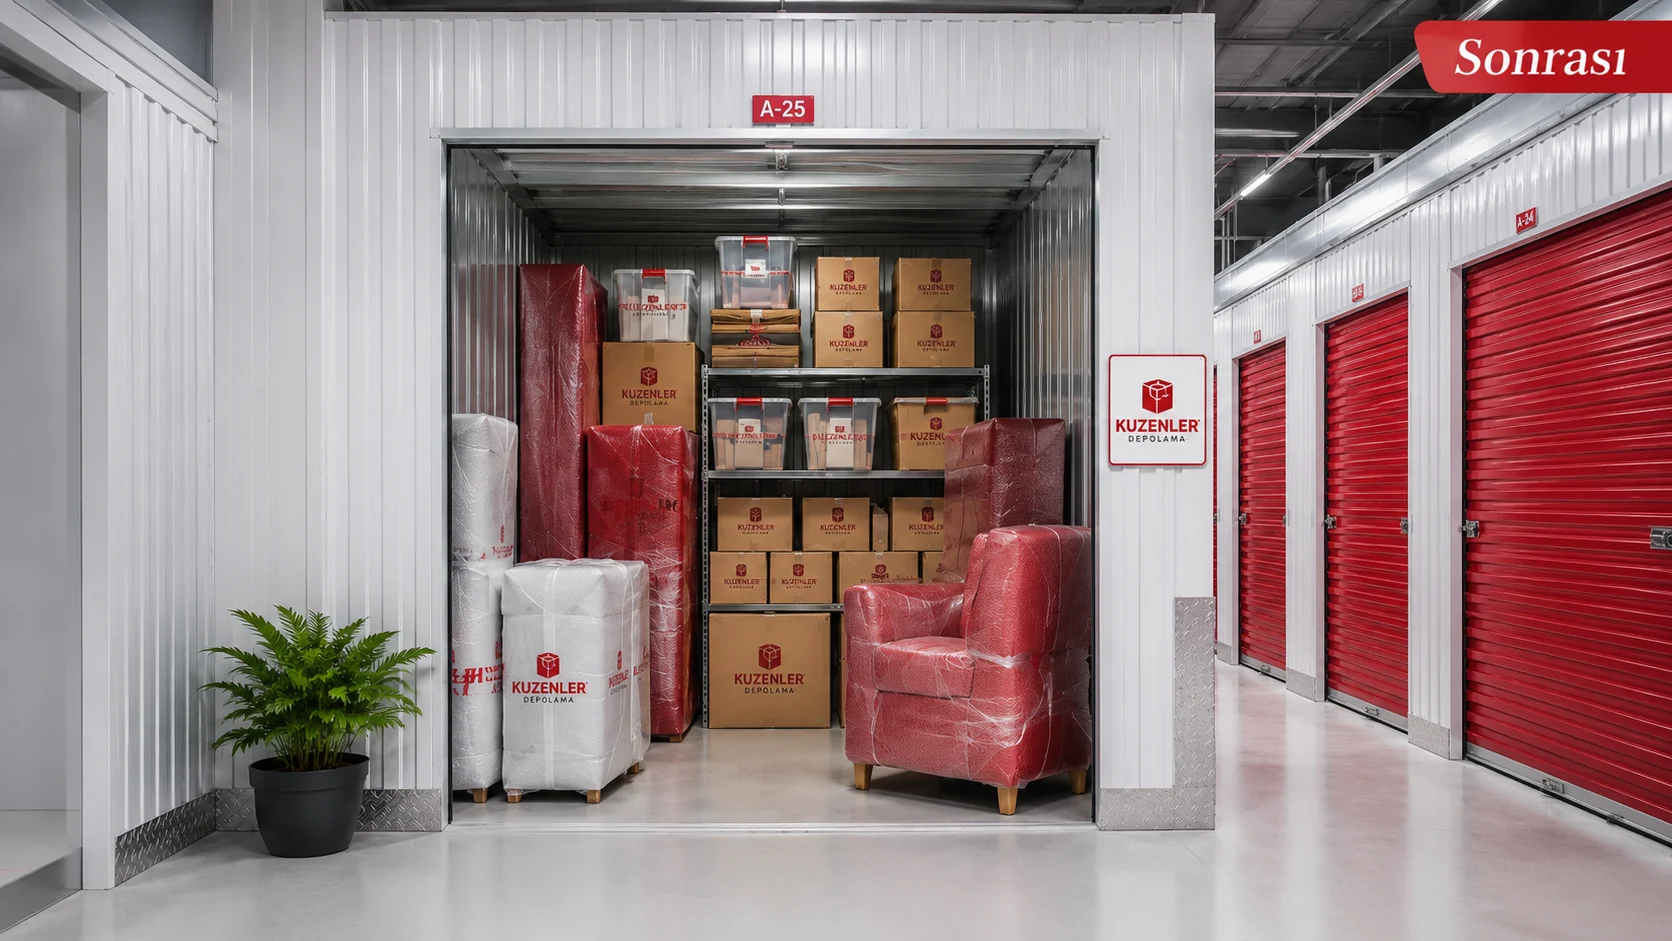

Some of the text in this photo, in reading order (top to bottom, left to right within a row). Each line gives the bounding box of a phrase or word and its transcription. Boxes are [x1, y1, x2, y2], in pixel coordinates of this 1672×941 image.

[760, 99, 806, 118] A-25
[1517, 210, 1534, 228] A-24
[621, 389, 677, 399] KUZENLER
[1115, 419, 1199, 433] KUZENLER
[910, 432, 946, 441] KUZENL
[1128, 435, 1186, 443] DEPOLAMA
[734, 673, 805, 685] KUZENLER
[511, 681, 587, 695] KUZENLER
[523, 696, 574, 704] DEPOLAMA
